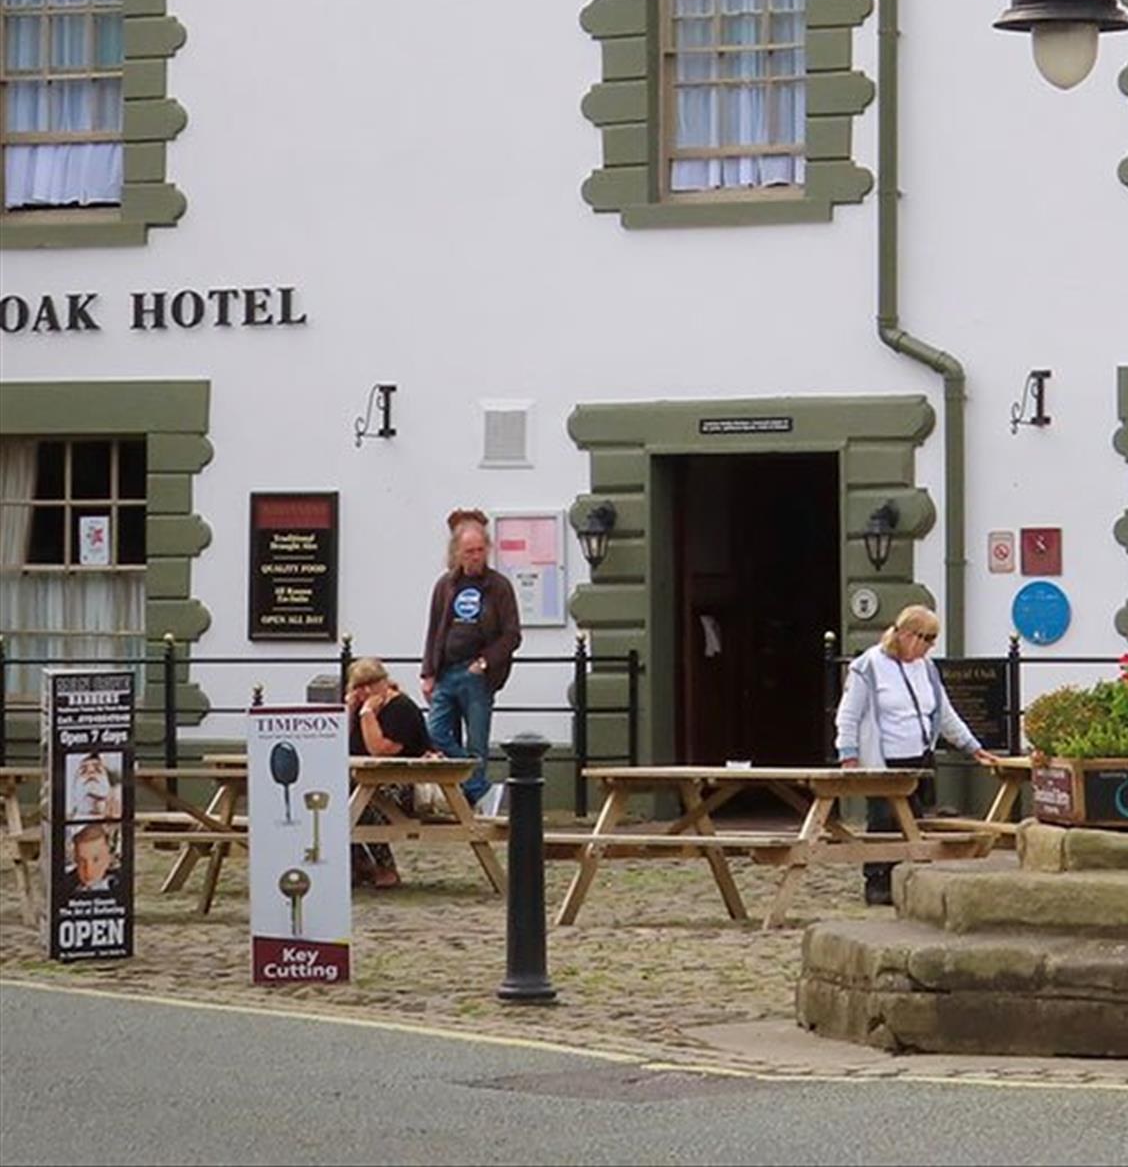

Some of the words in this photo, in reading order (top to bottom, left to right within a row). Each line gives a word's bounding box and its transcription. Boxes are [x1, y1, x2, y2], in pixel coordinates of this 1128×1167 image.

[0, 293, 101, 333] OAK
[130, 287, 306, 331] HOTEL
[261, 564, 299, 574] QUALITY
[301, 564, 328, 573] FOOD
[261, 615, 286, 625] OPEN
[288, 615, 303, 625] ALL
[305, 614, 325, 624] DAY
[257, 717, 340, 732] TIMPSON
[60, 730, 89, 747] Open
[91, 729, 100, 743] 7
[101, 729, 128, 745] days
[60, 919, 124, 948] OPEN
[282, 947, 319, 966] Key
[264, 963, 339, 982] Cutting
